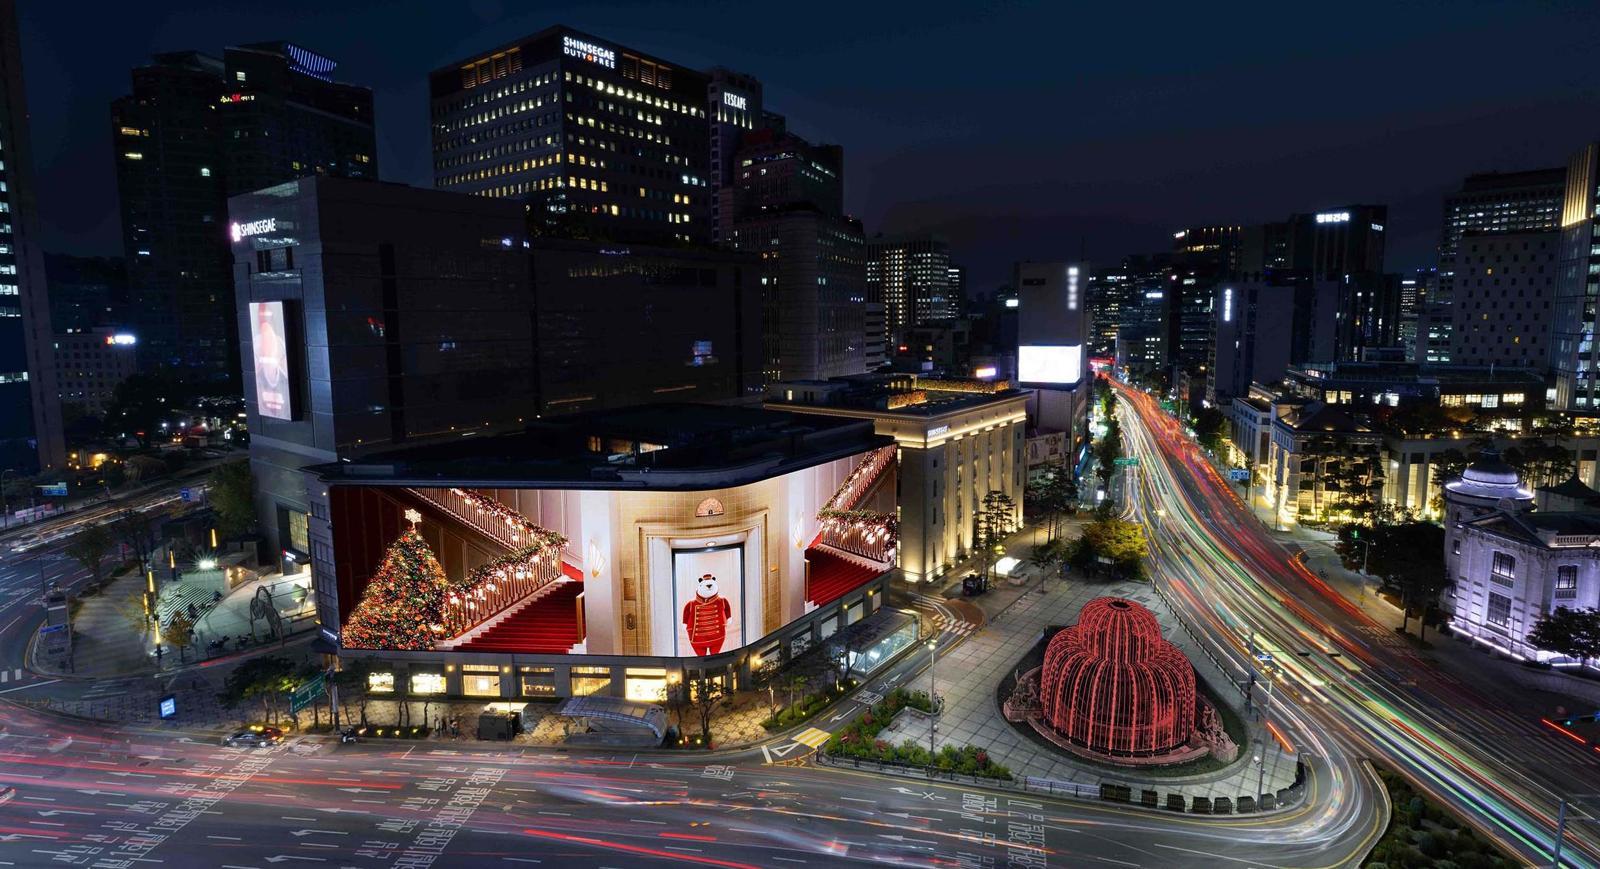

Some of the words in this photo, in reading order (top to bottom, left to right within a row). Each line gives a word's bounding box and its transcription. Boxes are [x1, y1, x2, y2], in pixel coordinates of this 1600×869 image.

[563, 36, 615, 61] SHINSEGAE
[563, 46, 587, 60] DUTY
[593, 55, 615, 69] FREE
[240, 218, 276, 237] SHINSEGAE
